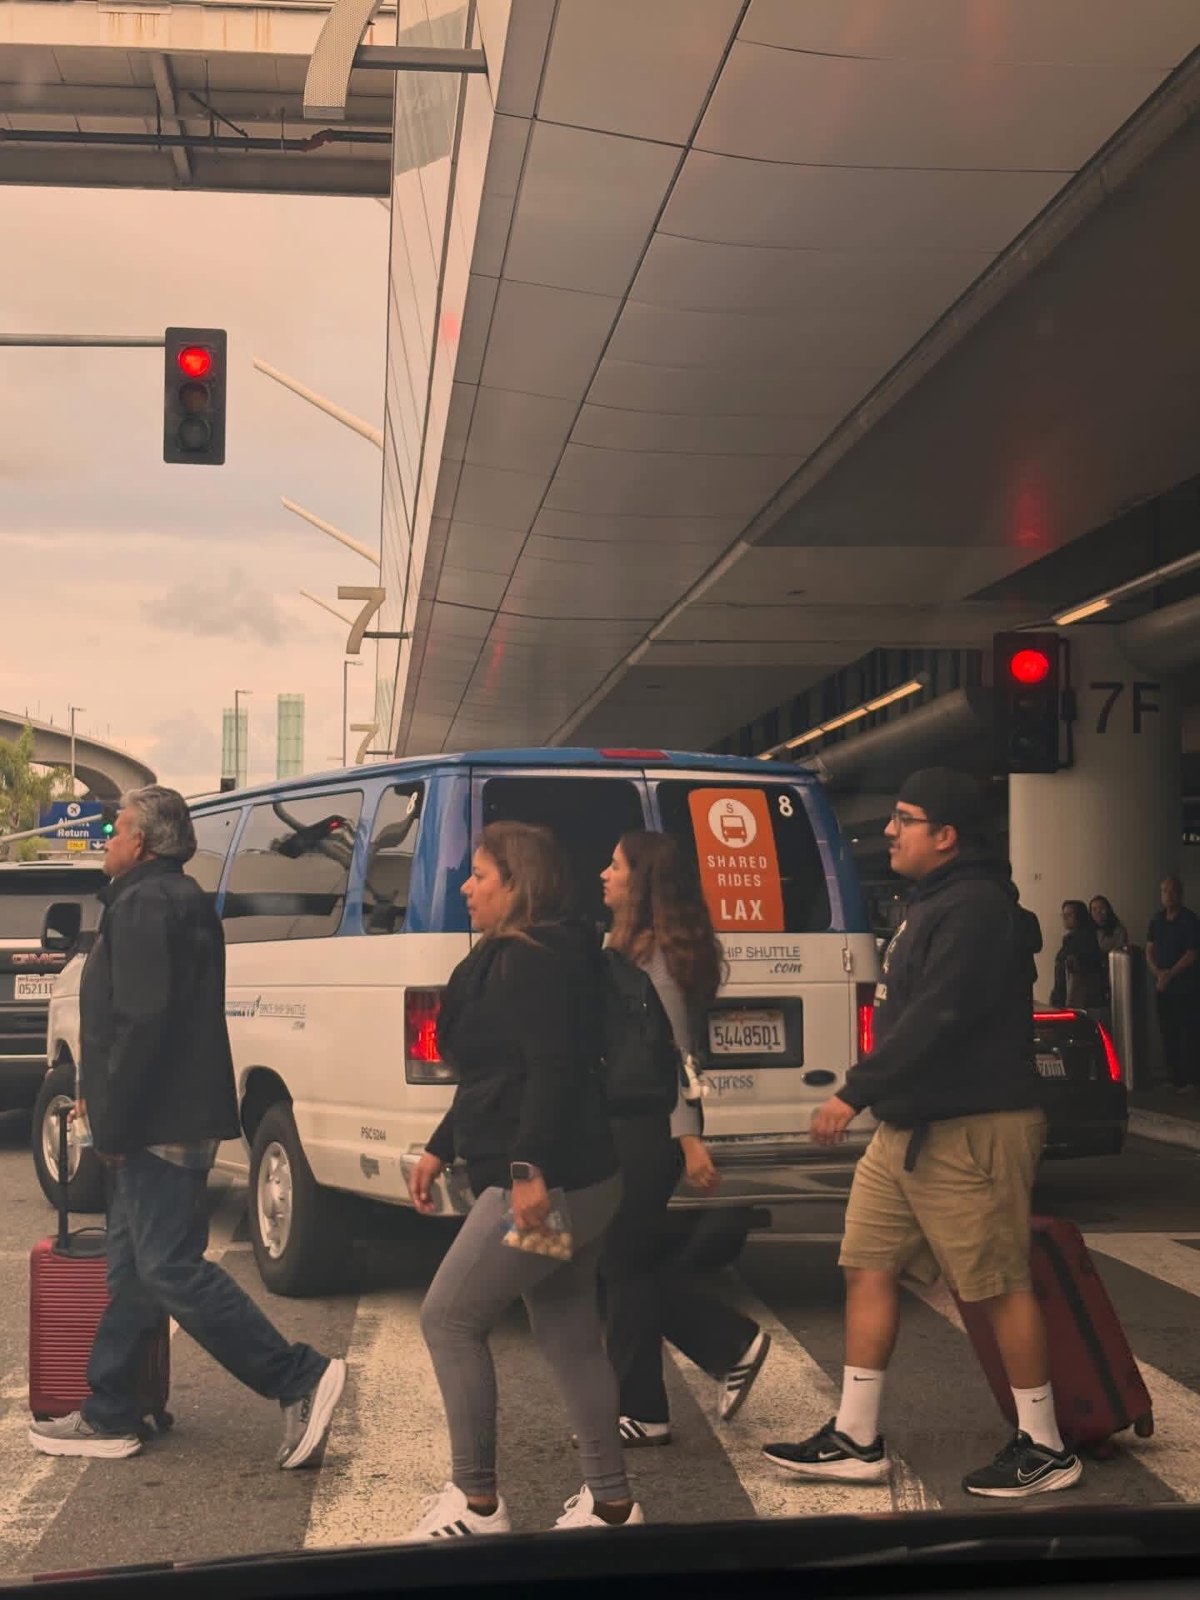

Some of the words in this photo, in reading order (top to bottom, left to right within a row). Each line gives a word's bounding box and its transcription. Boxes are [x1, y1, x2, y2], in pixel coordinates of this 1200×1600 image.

[337, 586, 386, 655] 7
[1089, 682, 1161, 734] 7F
[350, 723, 379, 765] 7
[778, 795, 793, 817] 8
[58, 828, 90, 838] Return
[707, 855, 768, 869] SHARED
[718, 873, 762, 887] RIDES
[720, 899, 765, 921] LAX
[12, 953, 66, 964] GMC
[746, 946, 800, 958] SHUTTLE
[769, 962, 803, 974] .com
[700, 1074, 755, 1092] xpress
